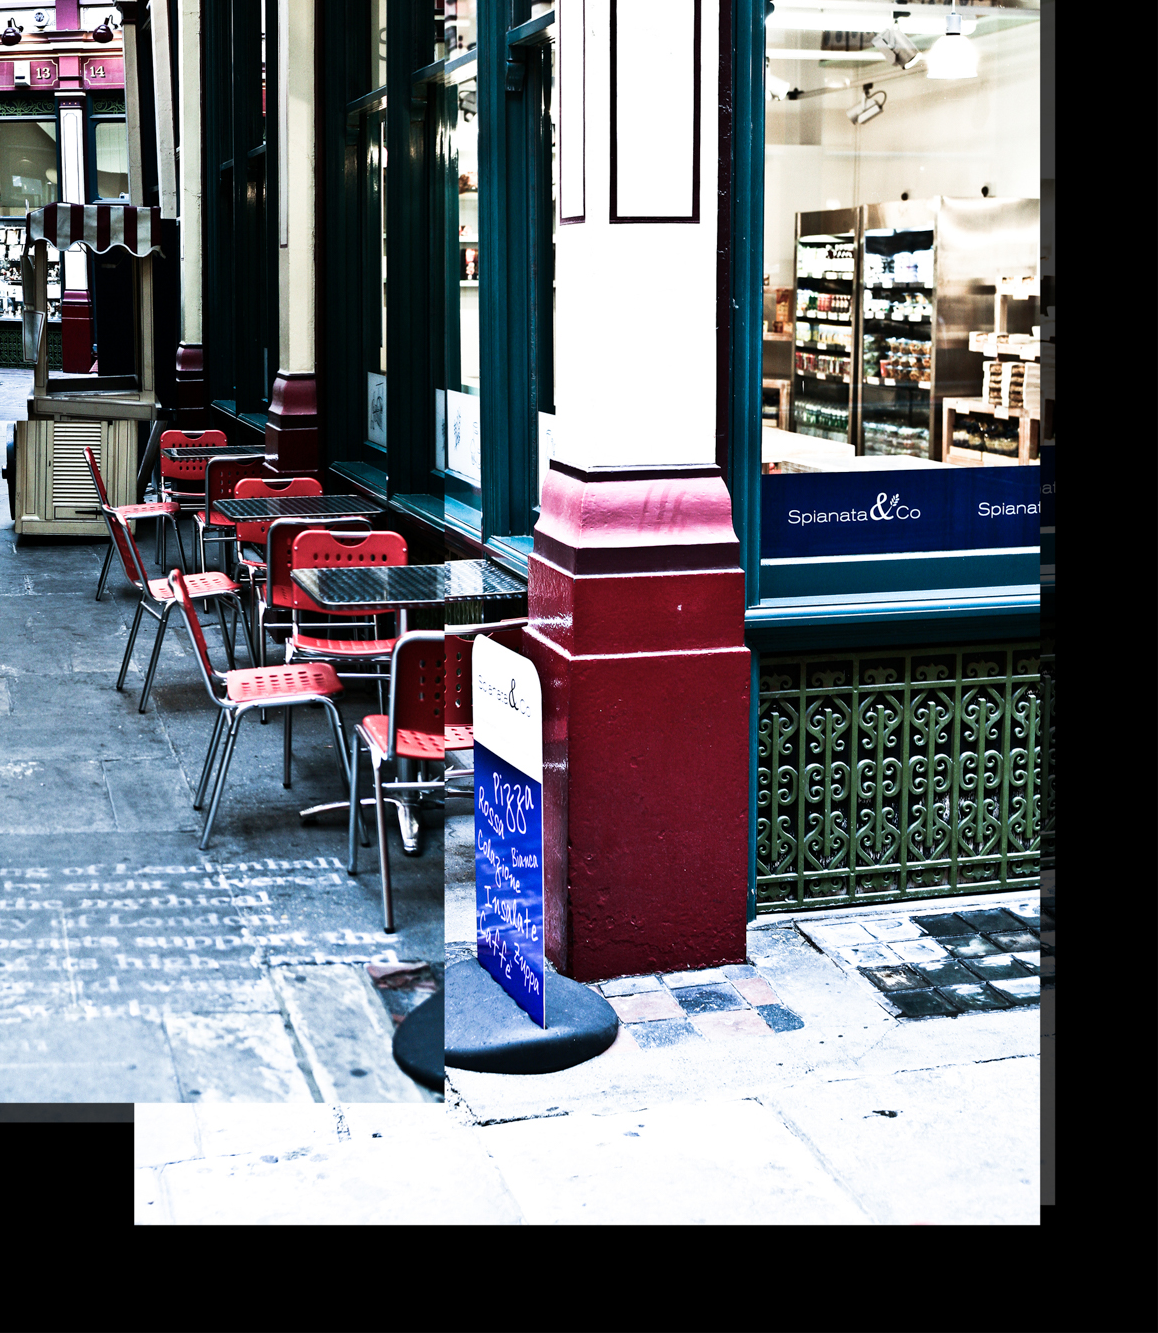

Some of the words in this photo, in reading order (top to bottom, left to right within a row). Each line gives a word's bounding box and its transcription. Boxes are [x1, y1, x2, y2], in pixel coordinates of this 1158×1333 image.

[35, 66, 51, 79] 13
[89, 65, 106, 78] 14
[478, 785, 505, 840] Rossa
[492, 771, 535, 835] Pizza
[62, 863, 106, 875] of
[115, 856, 346, 877] Leadenhall
[477, 828, 522, 894] Colazione
[510, 846, 539, 869] Bianca
[78, 892, 274, 910] mythical
[483, 884, 539, 942] Insalate
[135, 930, 313, 950] support
[324, 928, 400, 945] the
[479, 910, 512, 980] Caffè
